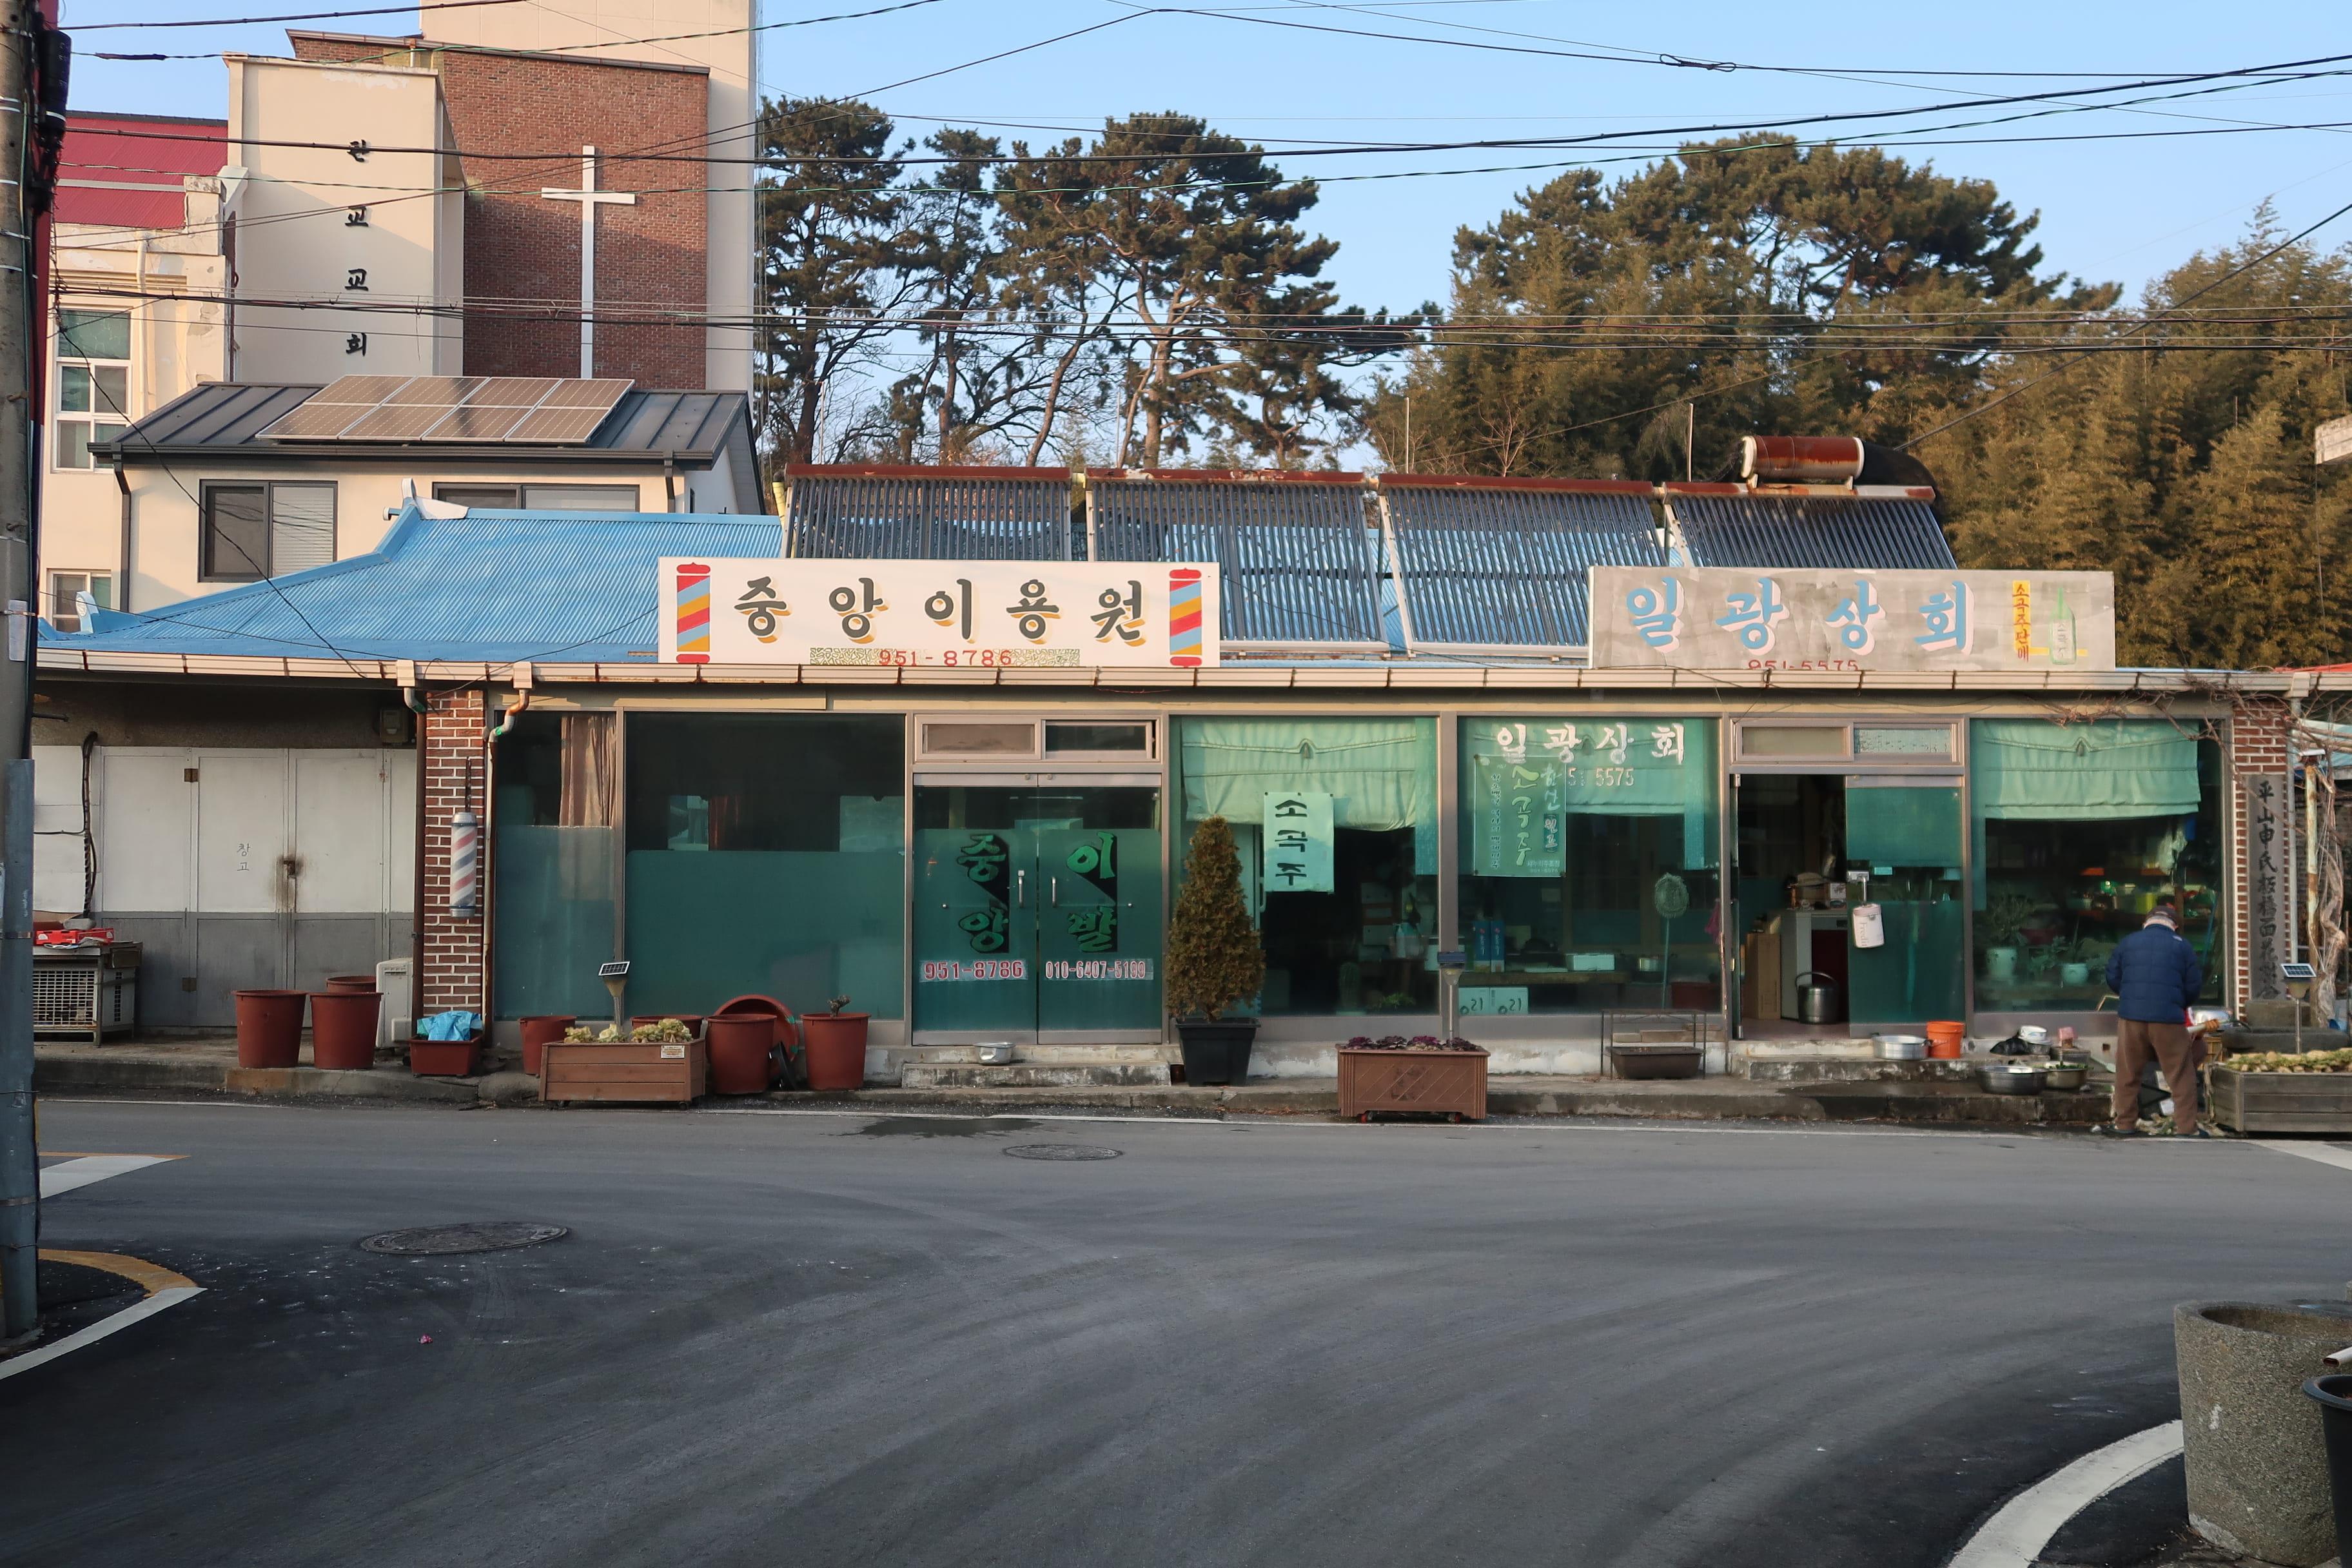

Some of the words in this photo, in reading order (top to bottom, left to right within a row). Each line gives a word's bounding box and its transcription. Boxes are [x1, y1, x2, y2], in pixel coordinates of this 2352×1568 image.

[733, 576, 1146, 643] 중앙이용원
[1626, 578, 1974, 654] 일광상회
[879, 649, 1012, 666] 951-8786
[1496, 722, 1685, 765] 일광상회
[1275, 799, 1308, 886] 소곡주
[1512, 765, 1540, 866] 소곡주
[237, 843, 251, 872] 창고
[1066, 832, 1117, 952] 이발
[957, 834, 1008, 953] 중앙
[924, 961, 1023, 980] 951-8786
